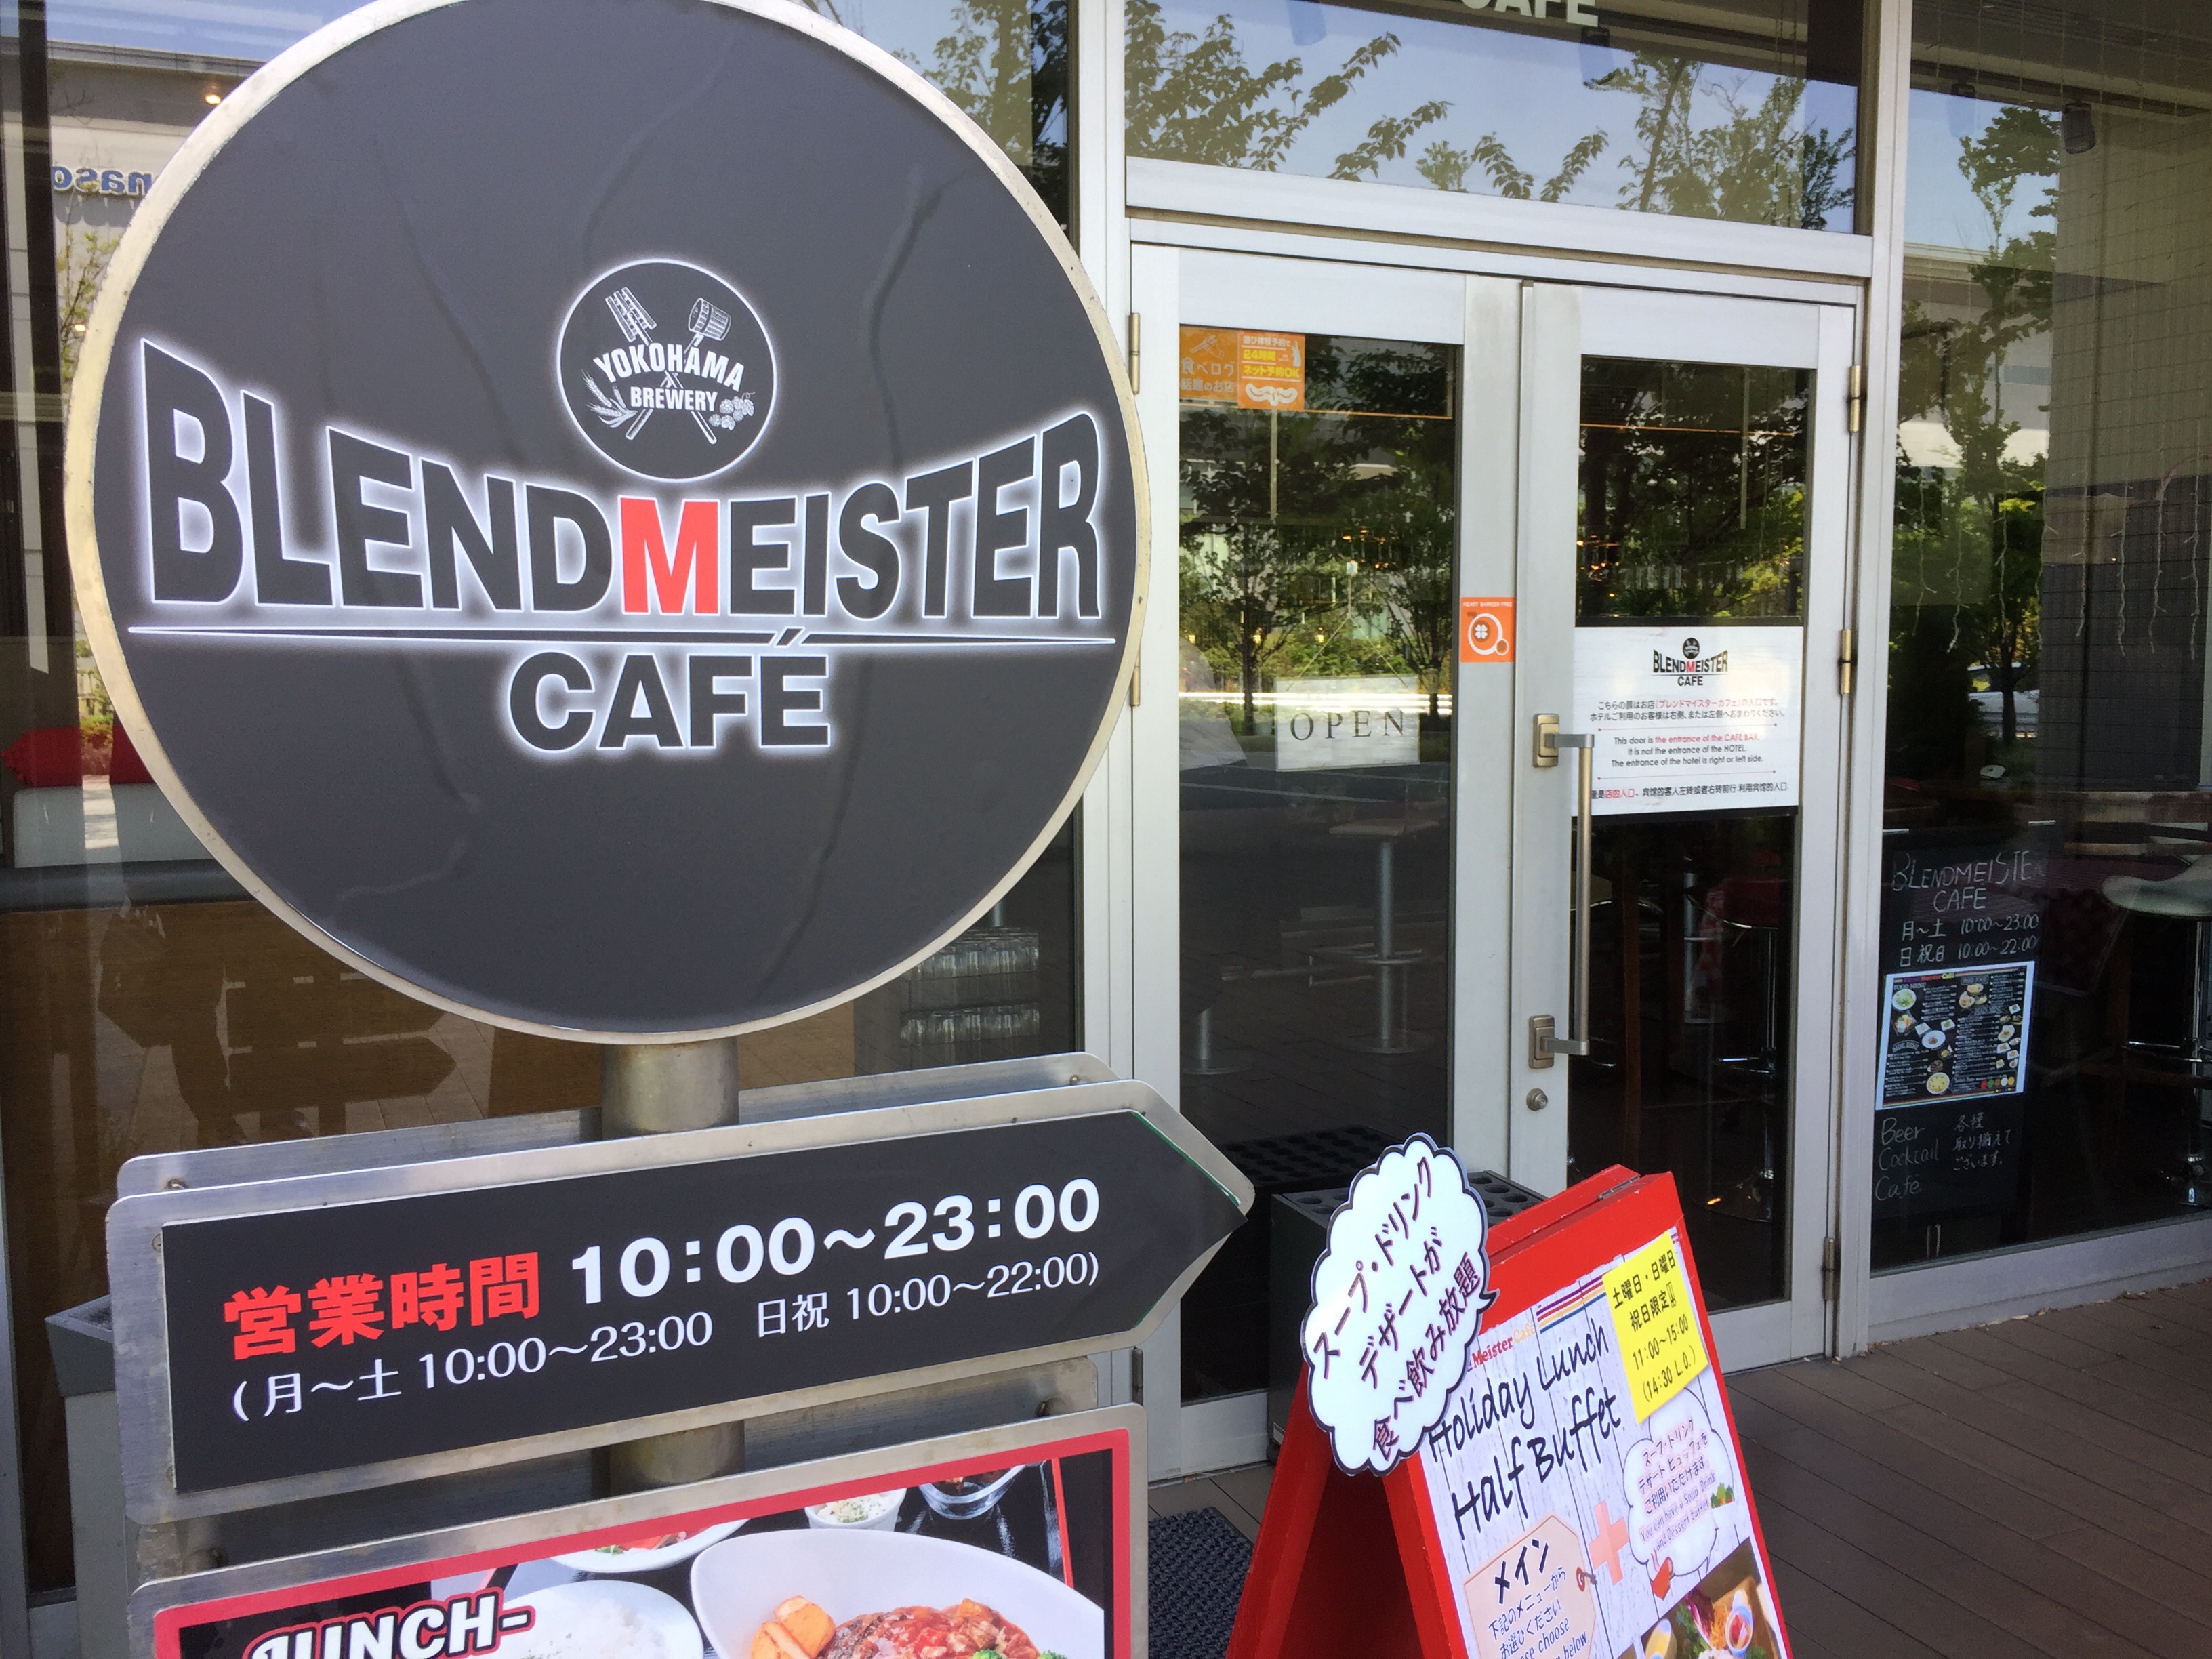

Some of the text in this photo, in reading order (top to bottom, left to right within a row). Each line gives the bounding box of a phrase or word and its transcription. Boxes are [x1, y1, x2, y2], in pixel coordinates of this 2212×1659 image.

[593, 342, 745, 392] YOKOHAMA
[1181, 356, 1235, 377] 食べログ
[1243, 349, 1276, 361] 24時間
[1243, 365, 1300, 379] ネット予約OK
[630, 386, 718, 412] BREWERY
[1181, 377, 1235, 394] 話題のお店
[140, 338, 1102, 620] BLENDMEISTER
[1653, 649, 1728, 673] BLENDMEISTER
[508, 626, 830, 751] CAFÉ
[1290, 709, 1404, 740] OPEN
[1614, 737, 1627, 745] This
[1668, 735, 1700, 743] entrance
[1702, 734, 1710, 742] of
[1626, 758, 1659, 766] entrance
[1709, 756, 1725, 765] right
[1748, 754, 1763, 762] side.
[1724, 744, 1746, 752] HOTEL.
[1881, 1117, 1925, 1145] Beer
[1953, 1112, 1985, 1131] 各種
[1879, 1138, 1940, 1171] Cocktail
[1952, 1129, 2011, 1151] 取り揃えて
[224, 1178, 1100, 1359] 営業時間 10:00～23:00
[1314, 1156, 1432, 1379] スープ・ドリンク
[1612, 1249, 1676, 1309] 土曜日・日曜日
[419, 1311, 714, 1389] 10:00～23:00
[758, 1292, 829, 1338] 日祝
[846, 1251, 1099, 1320] 10:00～22:00)
[1359, 1226, 1443, 1389] デザートが
[1372, 1252, 1482, 1462] 食べ飲み放題
[1472, 1336, 1513, 1368] Meister
[1633, 1313, 1689, 1370] 11:00～15:00
[1429, 1318, 1609, 1462] Holiday Lunch
[1452, 1387, 1621, 1540] Half Buffet
[1641, 1528, 1653, 1542] You
[1654, 1517, 1664, 1532] can
[1664, 1505, 1678, 1519] have
[1684, 1488, 1698, 1504] Soup
[1700, 1472, 1716, 1492] Drink
[1657, 1533, 1667, 1551] and
[1667, 1515, 1690, 1540] Dessert
[1494, 1538, 1549, 1605] メイン
[1488, 1566, 1567, 1641] 下記のメニューから
[1538, 1618, 1570, 1654] choose
